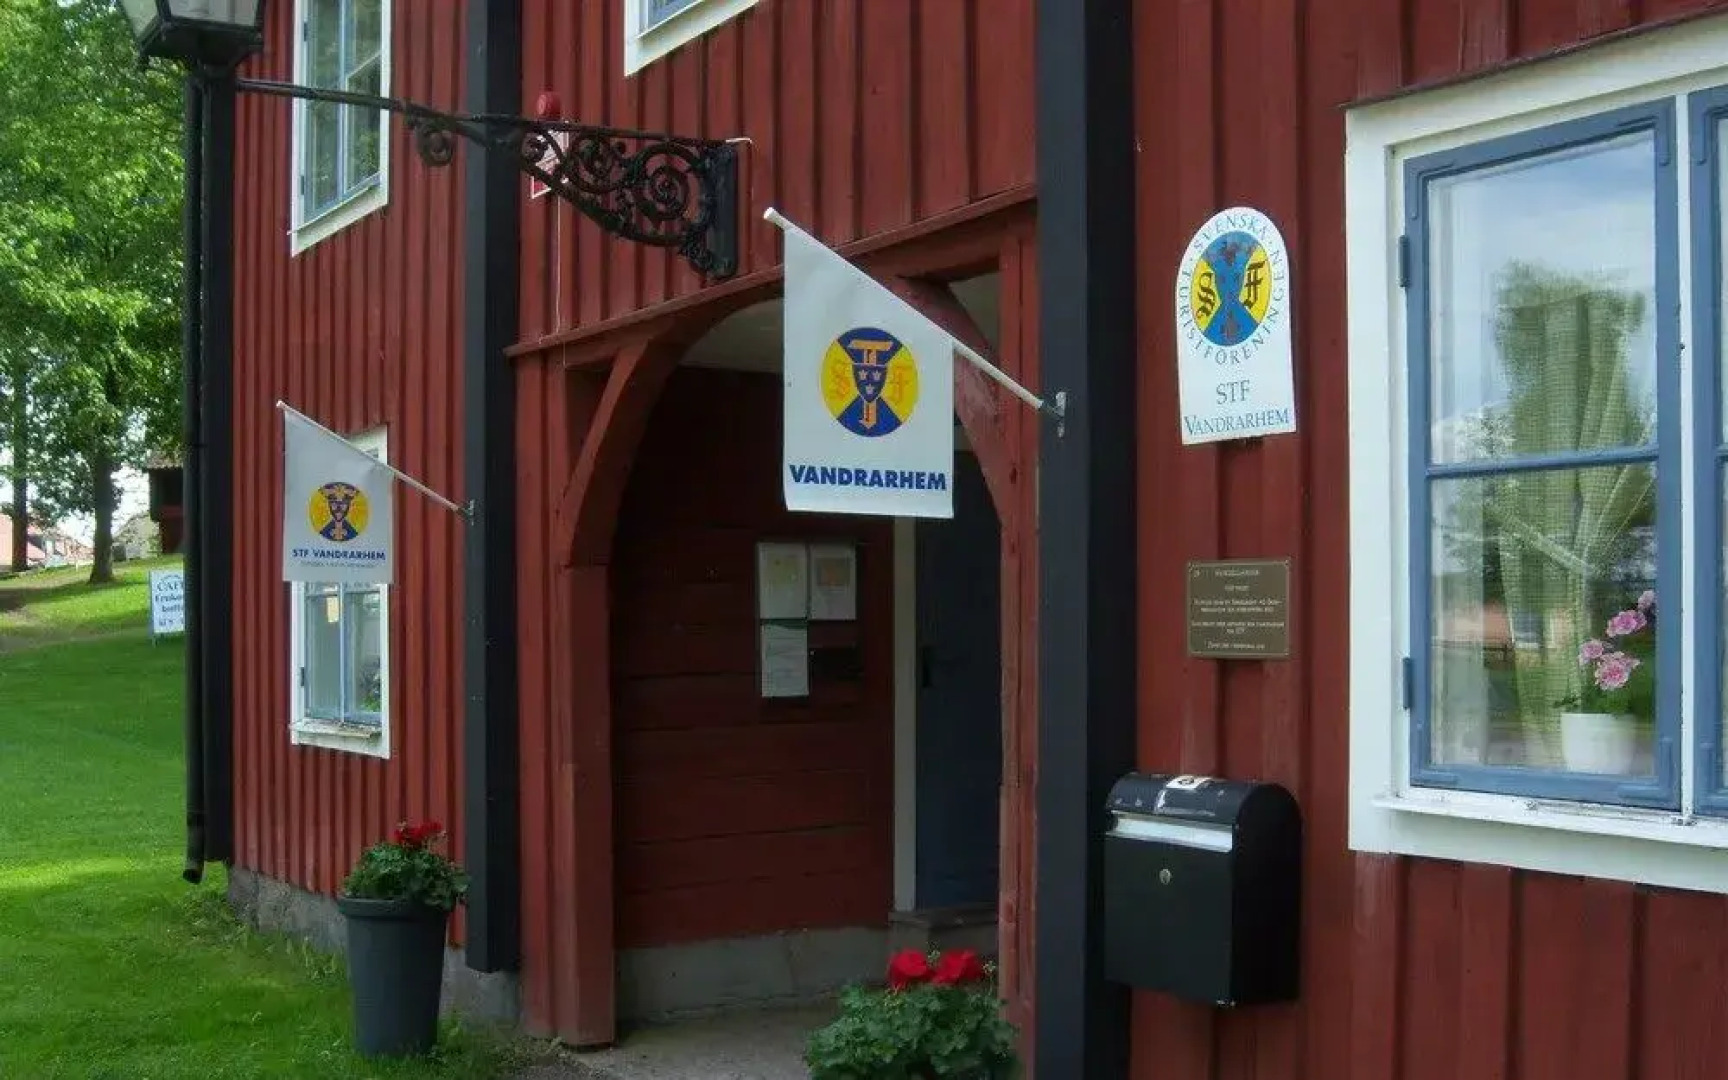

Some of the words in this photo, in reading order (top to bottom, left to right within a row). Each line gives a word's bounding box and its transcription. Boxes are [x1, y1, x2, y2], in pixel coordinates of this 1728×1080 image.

[1193, 213, 1268, 249] SVENSKA
[1215, 379, 1250, 405] STF
[1183, 407, 1290, 436] VANDRARHEM
[789, 464, 948, 492] VANDRARHEM
[291, 548, 310, 558] STF
[312, 549, 387, 561] VANDRARHEM
